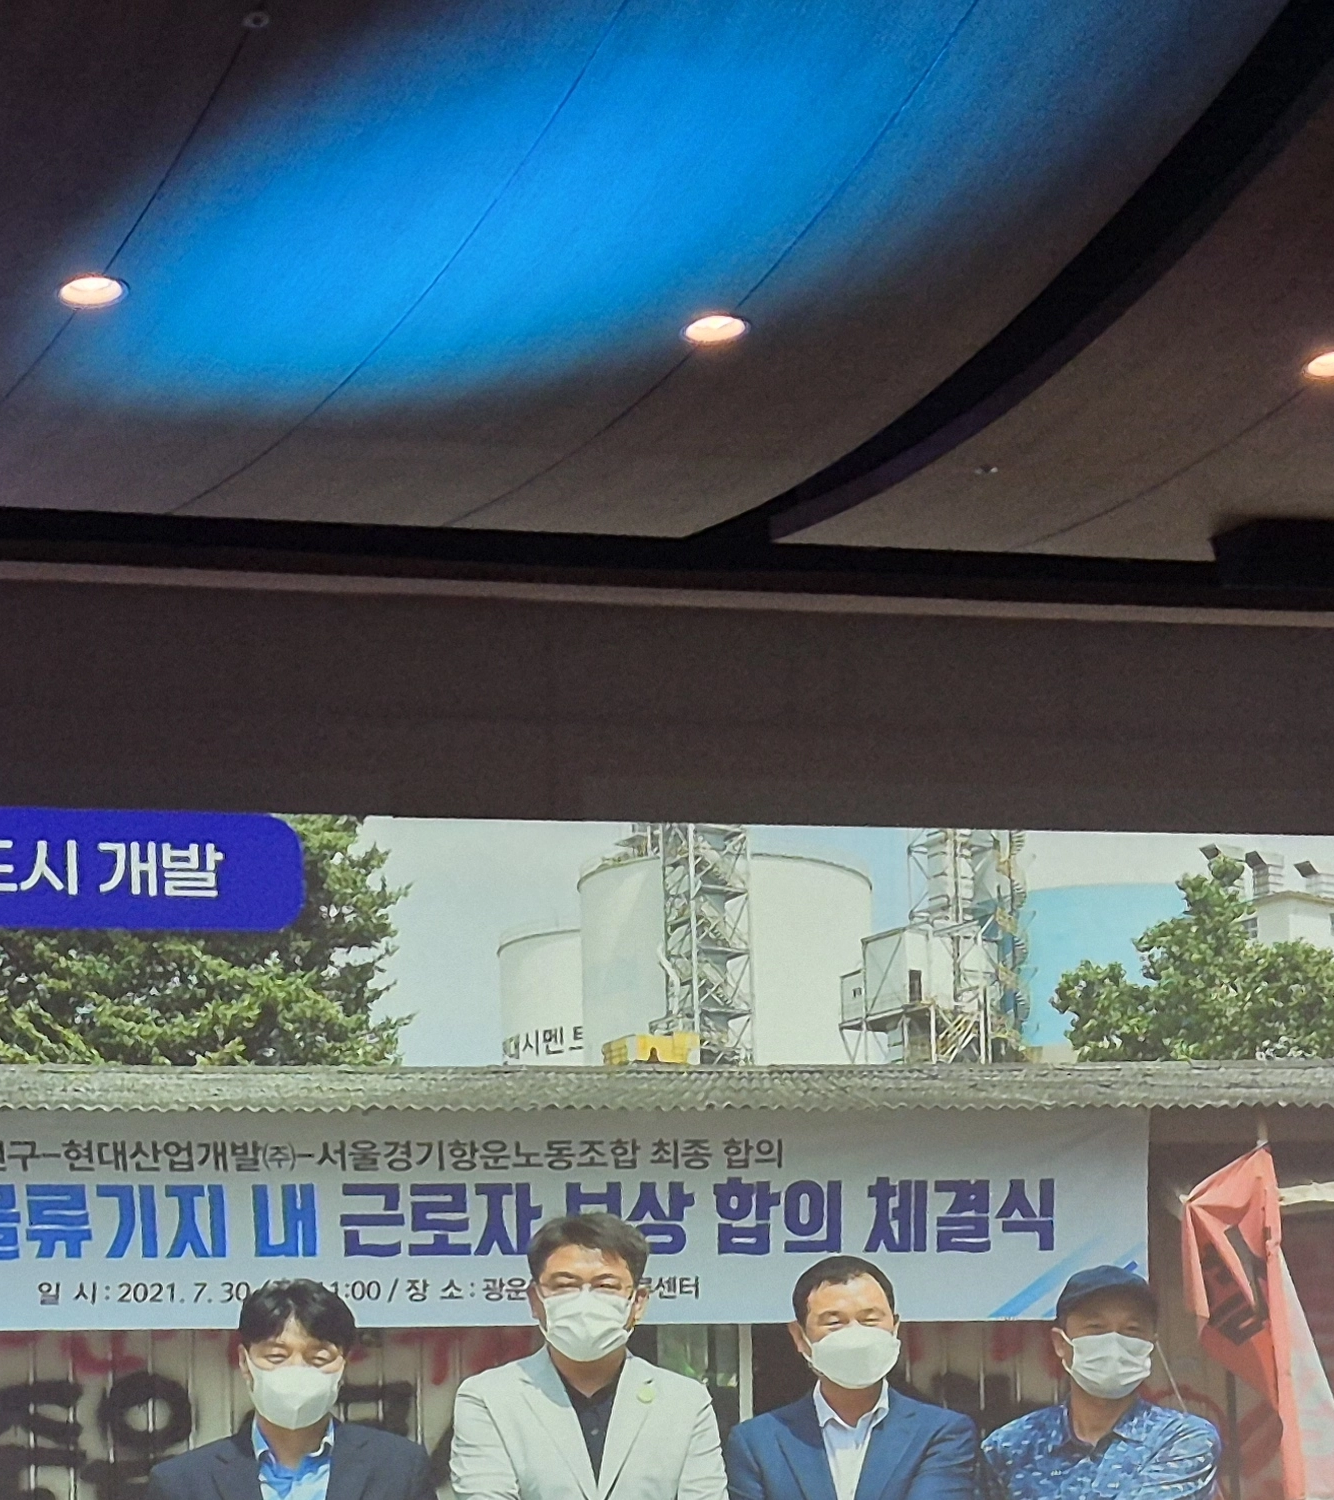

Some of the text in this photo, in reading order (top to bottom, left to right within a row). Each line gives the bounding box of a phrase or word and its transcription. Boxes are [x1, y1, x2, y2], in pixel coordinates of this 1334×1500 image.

[96, 838, 225, 899] 개발
[650, 1138, 713, 1170] 최종
[722, 1137, 785, 1169] 합의
[253, 1181, 319, 1260] 내
[338, 1181, 543, 1258] 근로자
[713, 1176, 843, 1256] 합의
[864, 1176, 1056, 1255] 체결식
